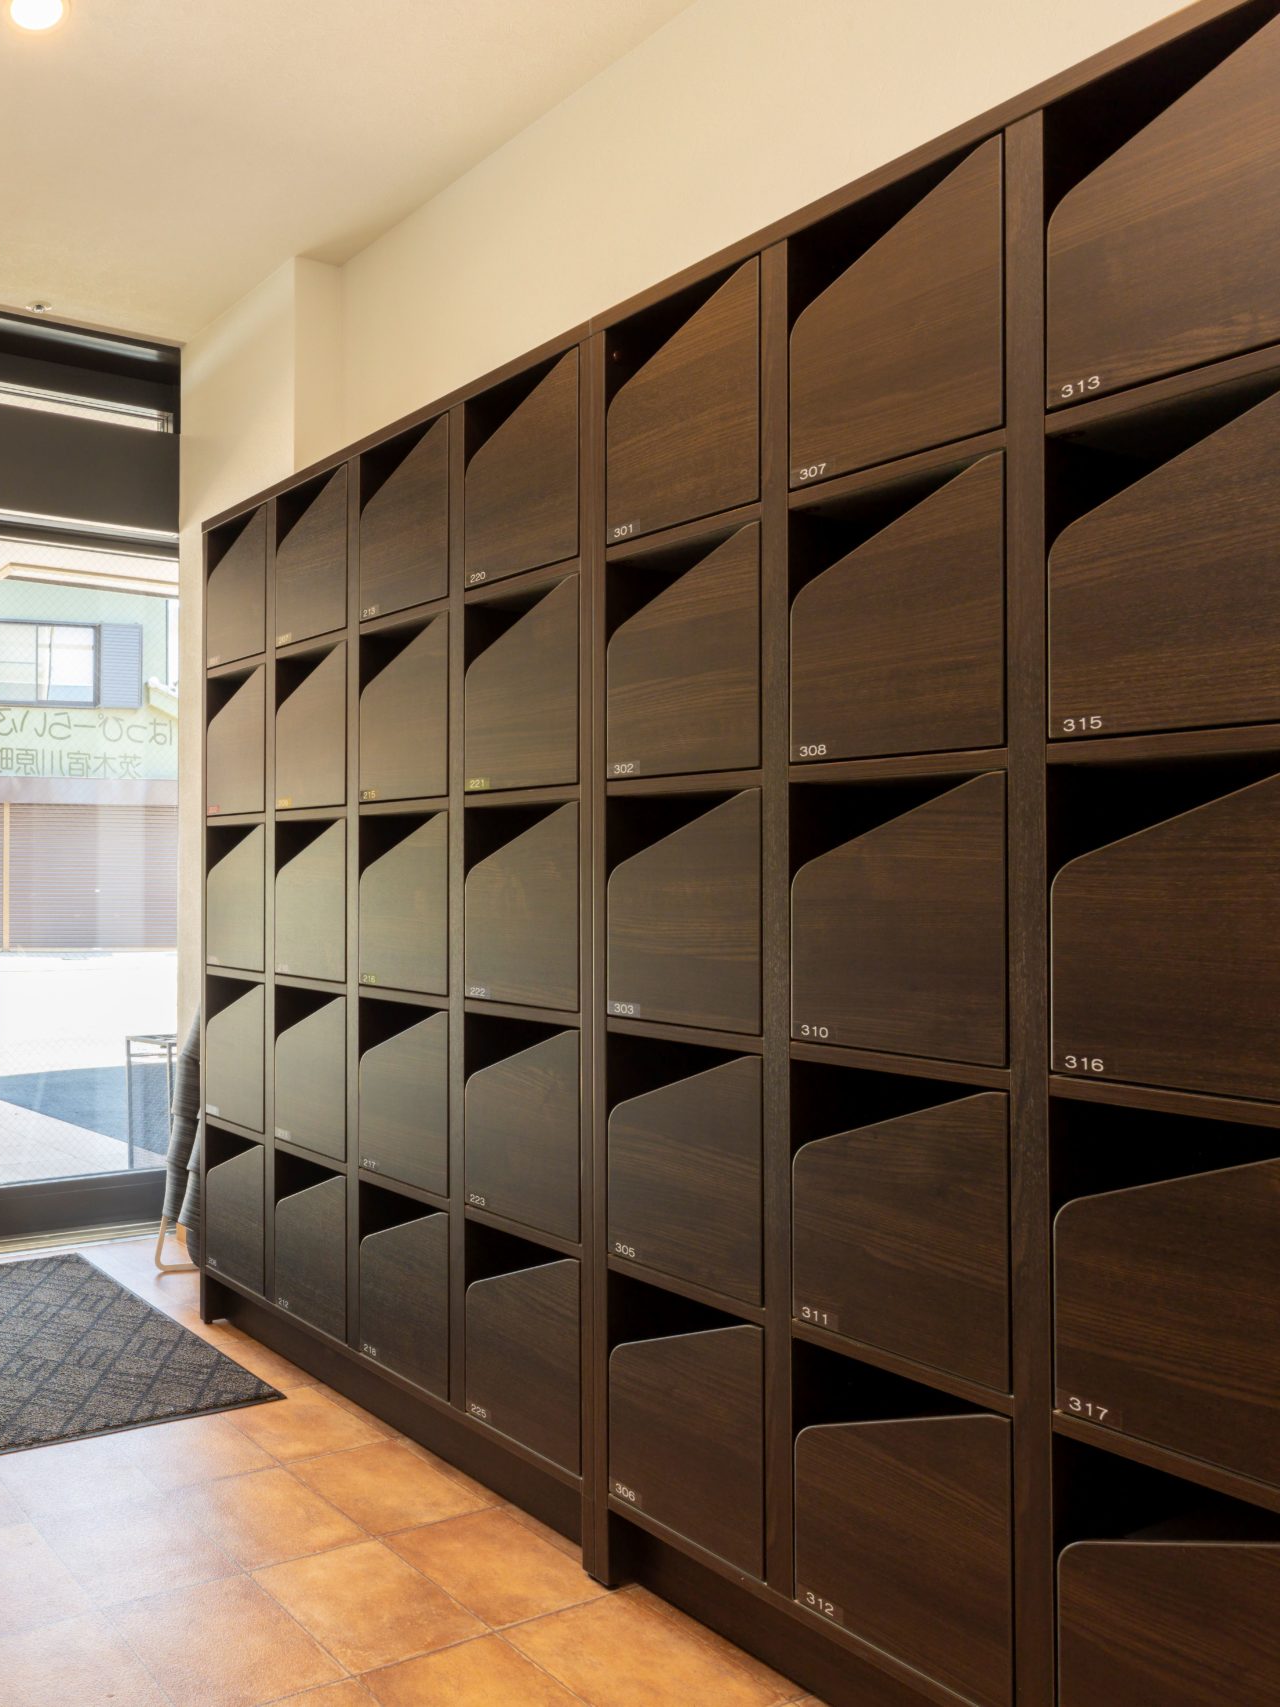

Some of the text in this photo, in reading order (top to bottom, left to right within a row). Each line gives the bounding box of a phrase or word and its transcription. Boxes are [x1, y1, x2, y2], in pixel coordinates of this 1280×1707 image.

[1060, 375, 1102, 399] 313
[798, 462, 828, 481] 307
[613, 523, 634, 539] 301
[470, 571, 486, 583] 220
[1062, 715, 1103, 733] 315
[799, 743, 828, 757] 308
[613, 763, 635, 775] 302
[469, 779, 485, 789] 221
[362, 790, 376, 800] 215
[362, 974, 376, 985] 216
[469, 986, 486, 998] 222
[613, 1002, 635, 1015] 303
[800, 1023, 829, 1039] 310
[1064, 1054, 1105, 1073] 316
[362, 1158, 376, 1169] 217
[469, 1193, 486, 1207] 223
[614, 1242, 636, 1258] 305
[278, 1297, 289, 1309] 212
[801, 1306, 829, 1326] 311
[363, 1343, 377, 1357] 218
[471, 1403, 487, 1419] 225
[1068, 1396, 1109, 1421] 317
[614, 1483, 636, 1503] 306
[805, 1591, 835, 1616] 312
